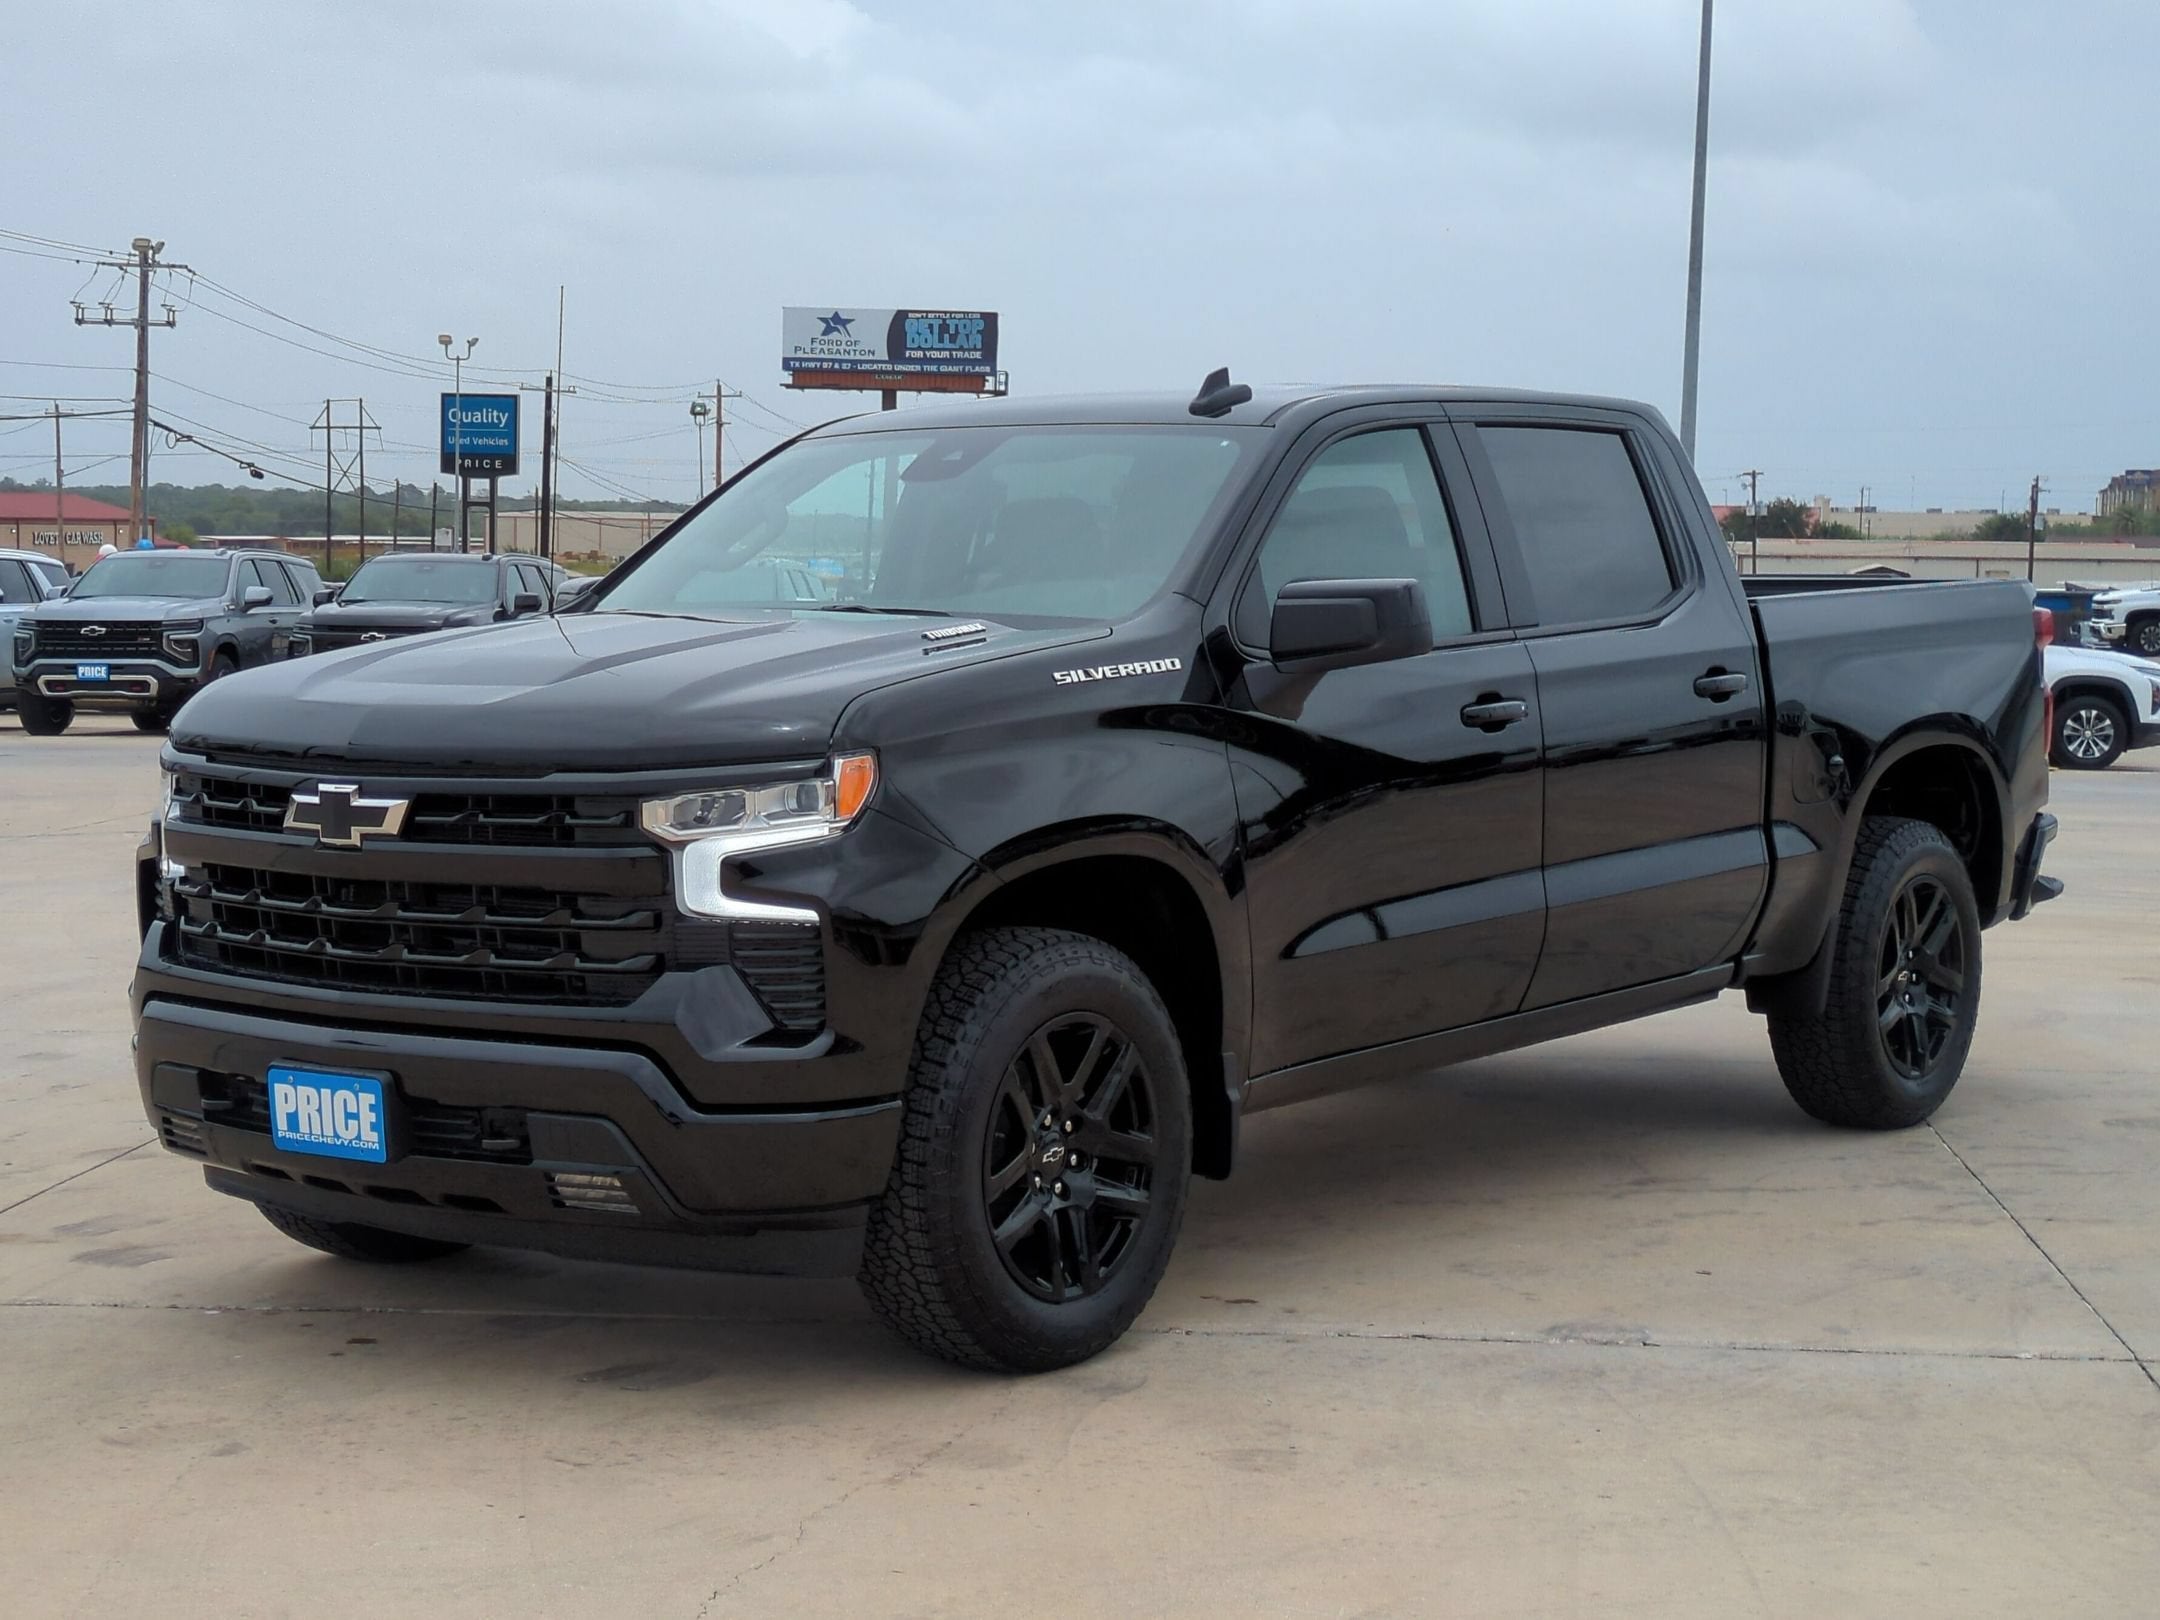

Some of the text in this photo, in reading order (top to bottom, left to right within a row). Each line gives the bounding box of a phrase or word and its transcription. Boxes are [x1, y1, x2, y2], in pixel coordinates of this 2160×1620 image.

[946, 319, 985, 334] TOP
[810, 337, 861, 348] FORD OF
[906, 332, 982, 349] DOLLAR
[794, 345, 876, 357] PLEASANTON
[905, 350, 982, 359] FOR YOUR TRADE
[802, 361, 821, 369] HWY
[857, 363, 893, 371] LOCATED
[940, 365, 964, 373] GIANT
[448, 408, 509, 428] Quality
[448, 436, 509, 446] Ued Vehicles
[65, 531, 81, 544] CAR
[82, 532, 104, 544] WASH
[78, 665, 107, 679] PRICE
[1053, 657, 1182, 685] SILVERADO
[274, 1083, 378, 1142] PRICE
[278, 1130, 380, 1150] PRICECHEVY.COM
